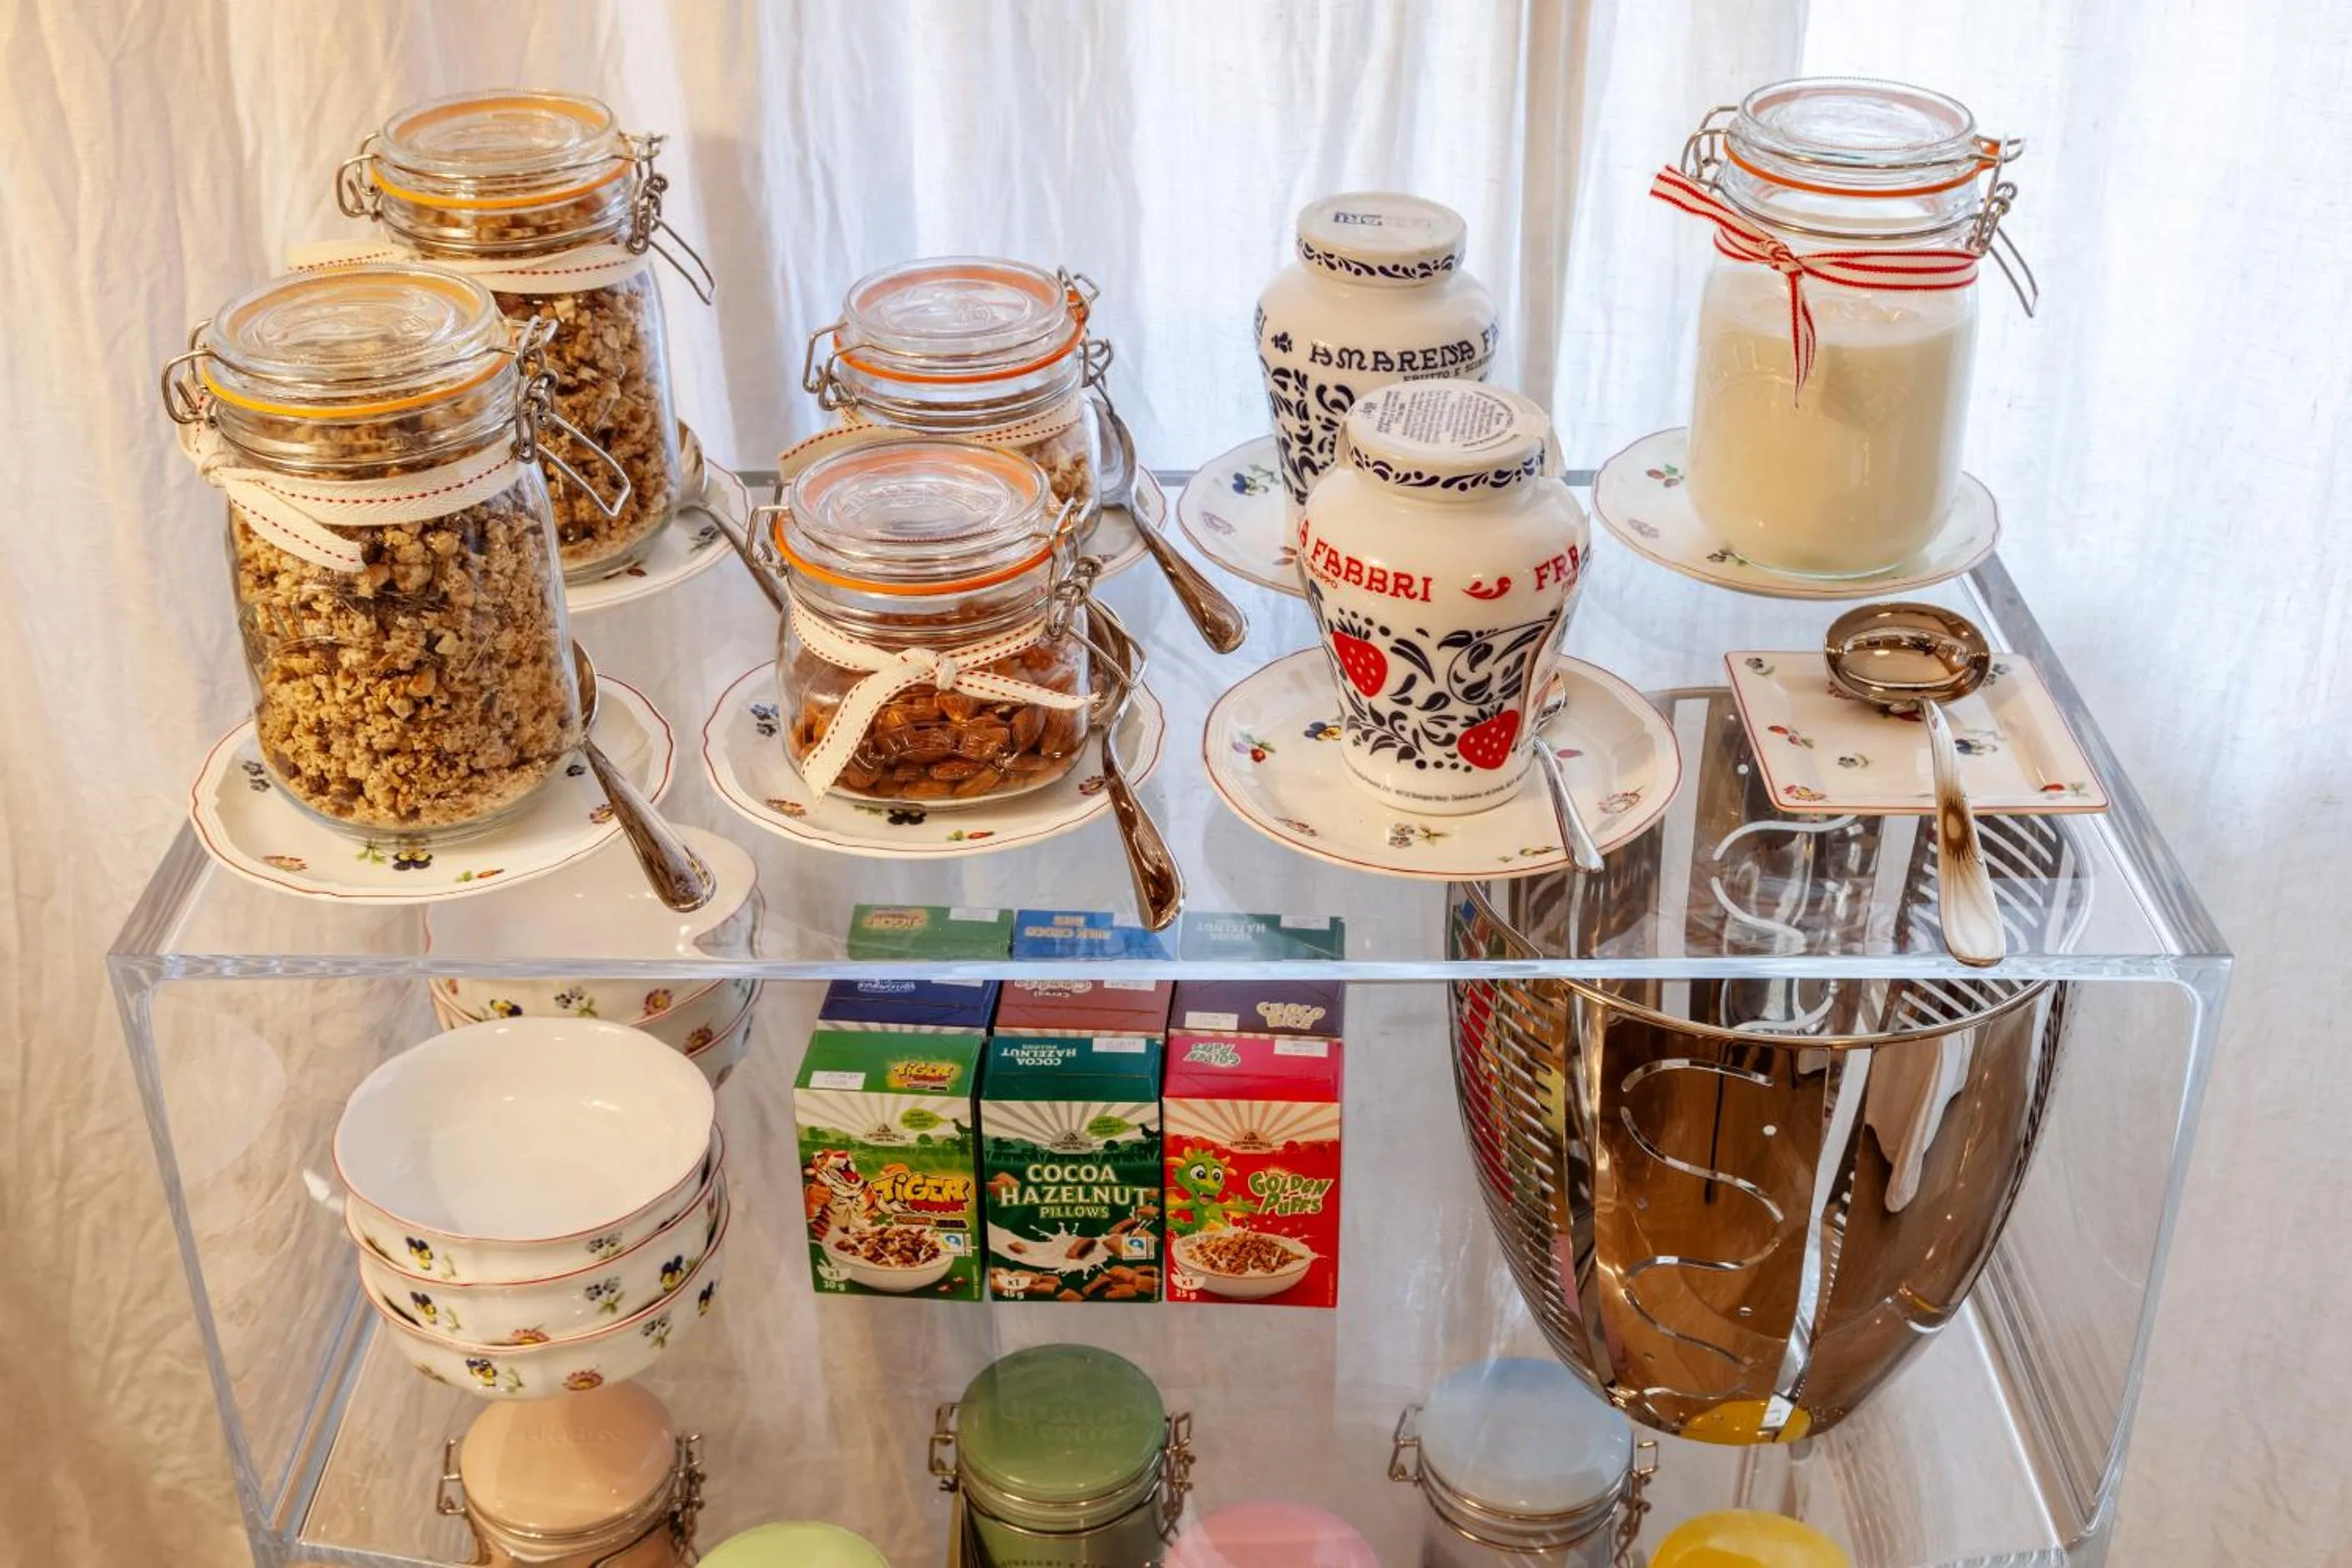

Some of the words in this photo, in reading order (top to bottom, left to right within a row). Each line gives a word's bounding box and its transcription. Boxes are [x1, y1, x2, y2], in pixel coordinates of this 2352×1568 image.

[1311, 537, 1433, 602] FABBRI
[1000, 1048, 1077, 1058] HAZELNUT
[1017, 1058, 1062, 1067] COCOA
[1025, 1163, 1117, 1183] COCOA
[999, 1186, 1151, 1207] HAZELNUT
[1039, 1206, 1110, 1219] PILLOWS
[1174, 1289, 1188, 1298] 25
